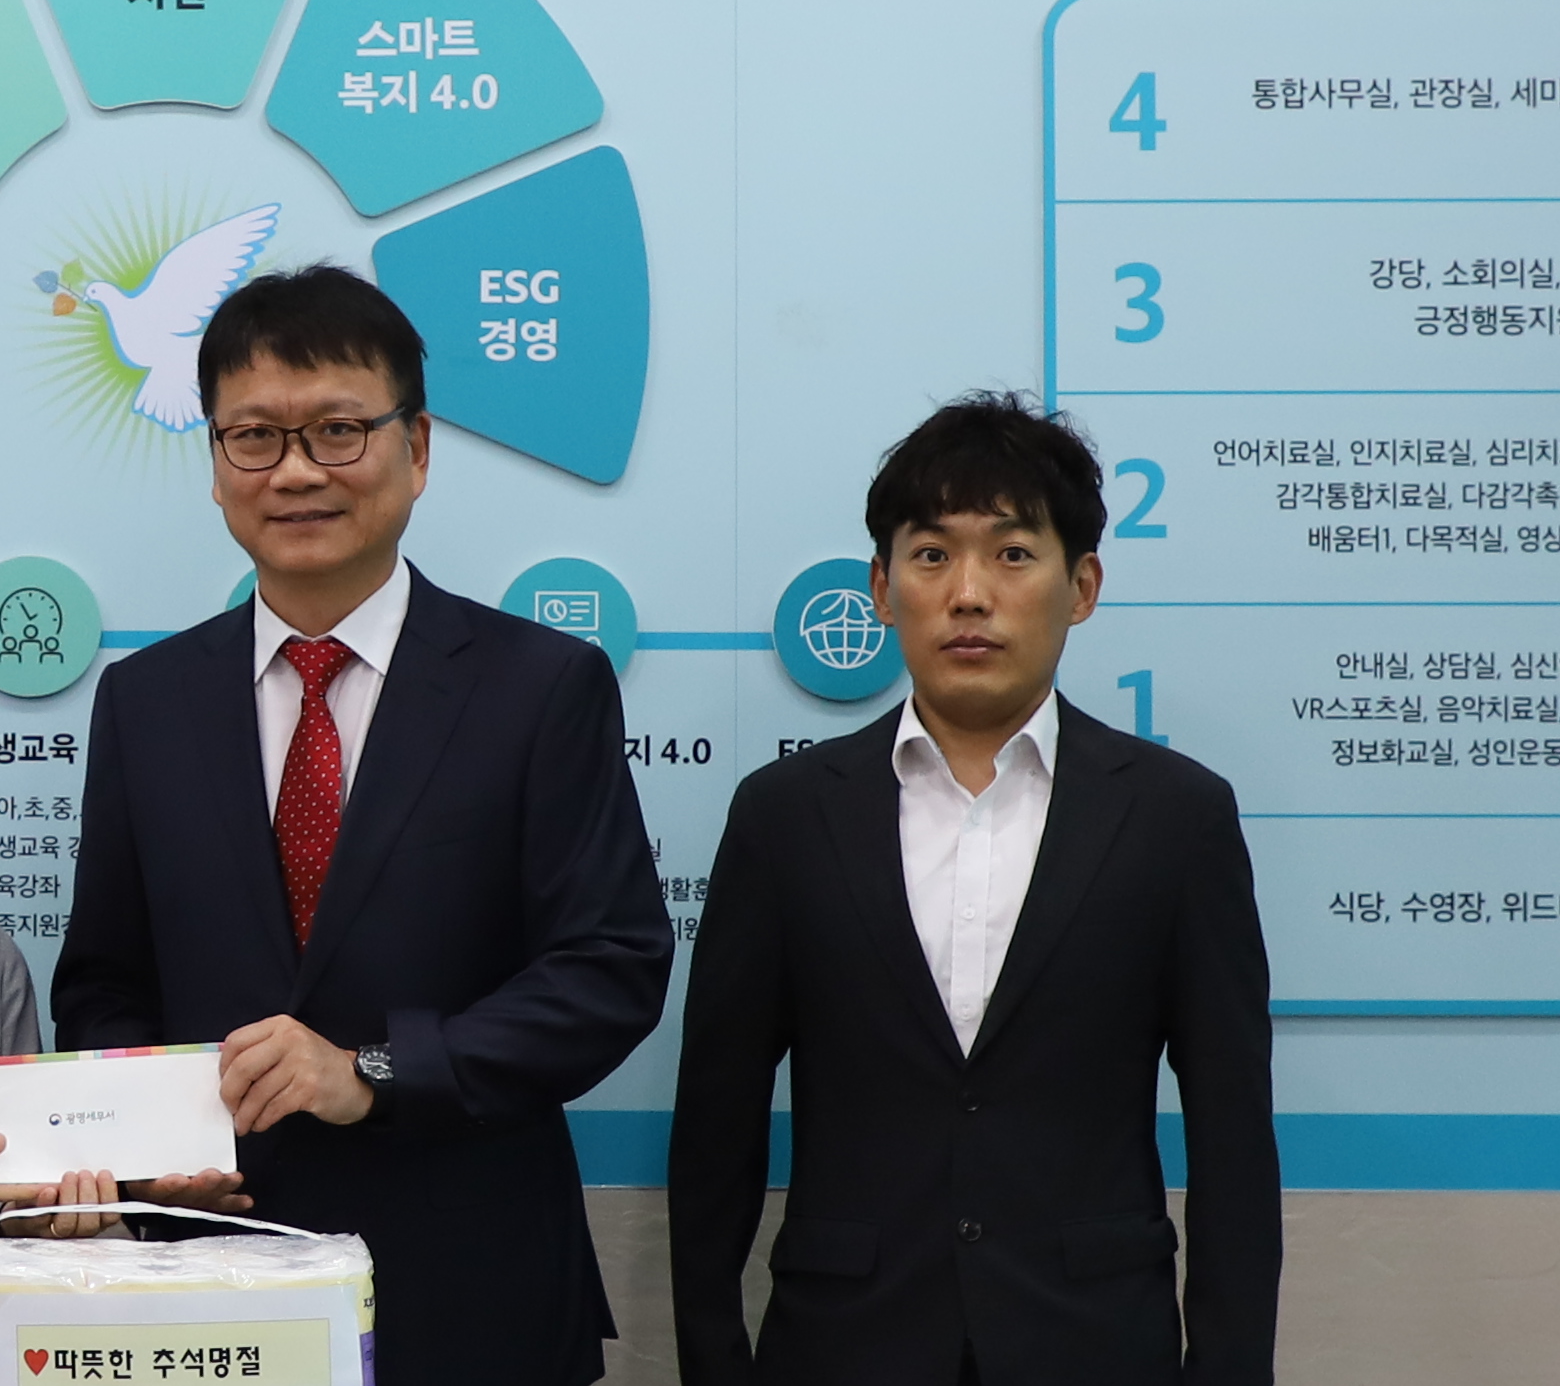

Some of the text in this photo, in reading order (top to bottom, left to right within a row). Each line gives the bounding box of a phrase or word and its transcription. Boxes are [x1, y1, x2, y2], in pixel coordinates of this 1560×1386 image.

[357, 18, 479, 59] 스마트
[338, 71, 498, 113] 복지 4.0
[1253, 79, 1398, 109] 통합사무실,
[1410, 78, 1499, 108] 관장실,
[1109, 72, 1167, 151] 4
[481, 270, 559, 303] ESG
[1371, 259, 1430, 289] 강당,
[1443, 259, 1560, 289] 소회의실,
[1115, 262, 1164, 343] 3
[479, 318, 556, 361] 경영
[1214, 440, 1340, 466] 언어치료실,
[1350, 439, 1476, 466] 인지치료실,
[1114, 458, 1167, 538] 2
[1278, 482, 1452, 510] 감각통합치료실,
[1309, 526, 1396, 552] 배움터1,
[1407, 526, 1507, 552] 다목적실,
[1336, 653, 1413, 679] 안내실,
[1424, 653, 1500, 680] 상담실,
[1117, 670, 1169, 746] 1
[1293, 696, 1427, 723] VR스포츠실,
[1333, 739, 1458, 766] 정보화교실,
[1330, 892, 1389, 922] 식당,
[1402, 892, 1490, 923] 수영장,
[65, 1109, 116, 1126] 광명세무서
[55, 1347, 259, 1379] 따뜻한 추석명절
